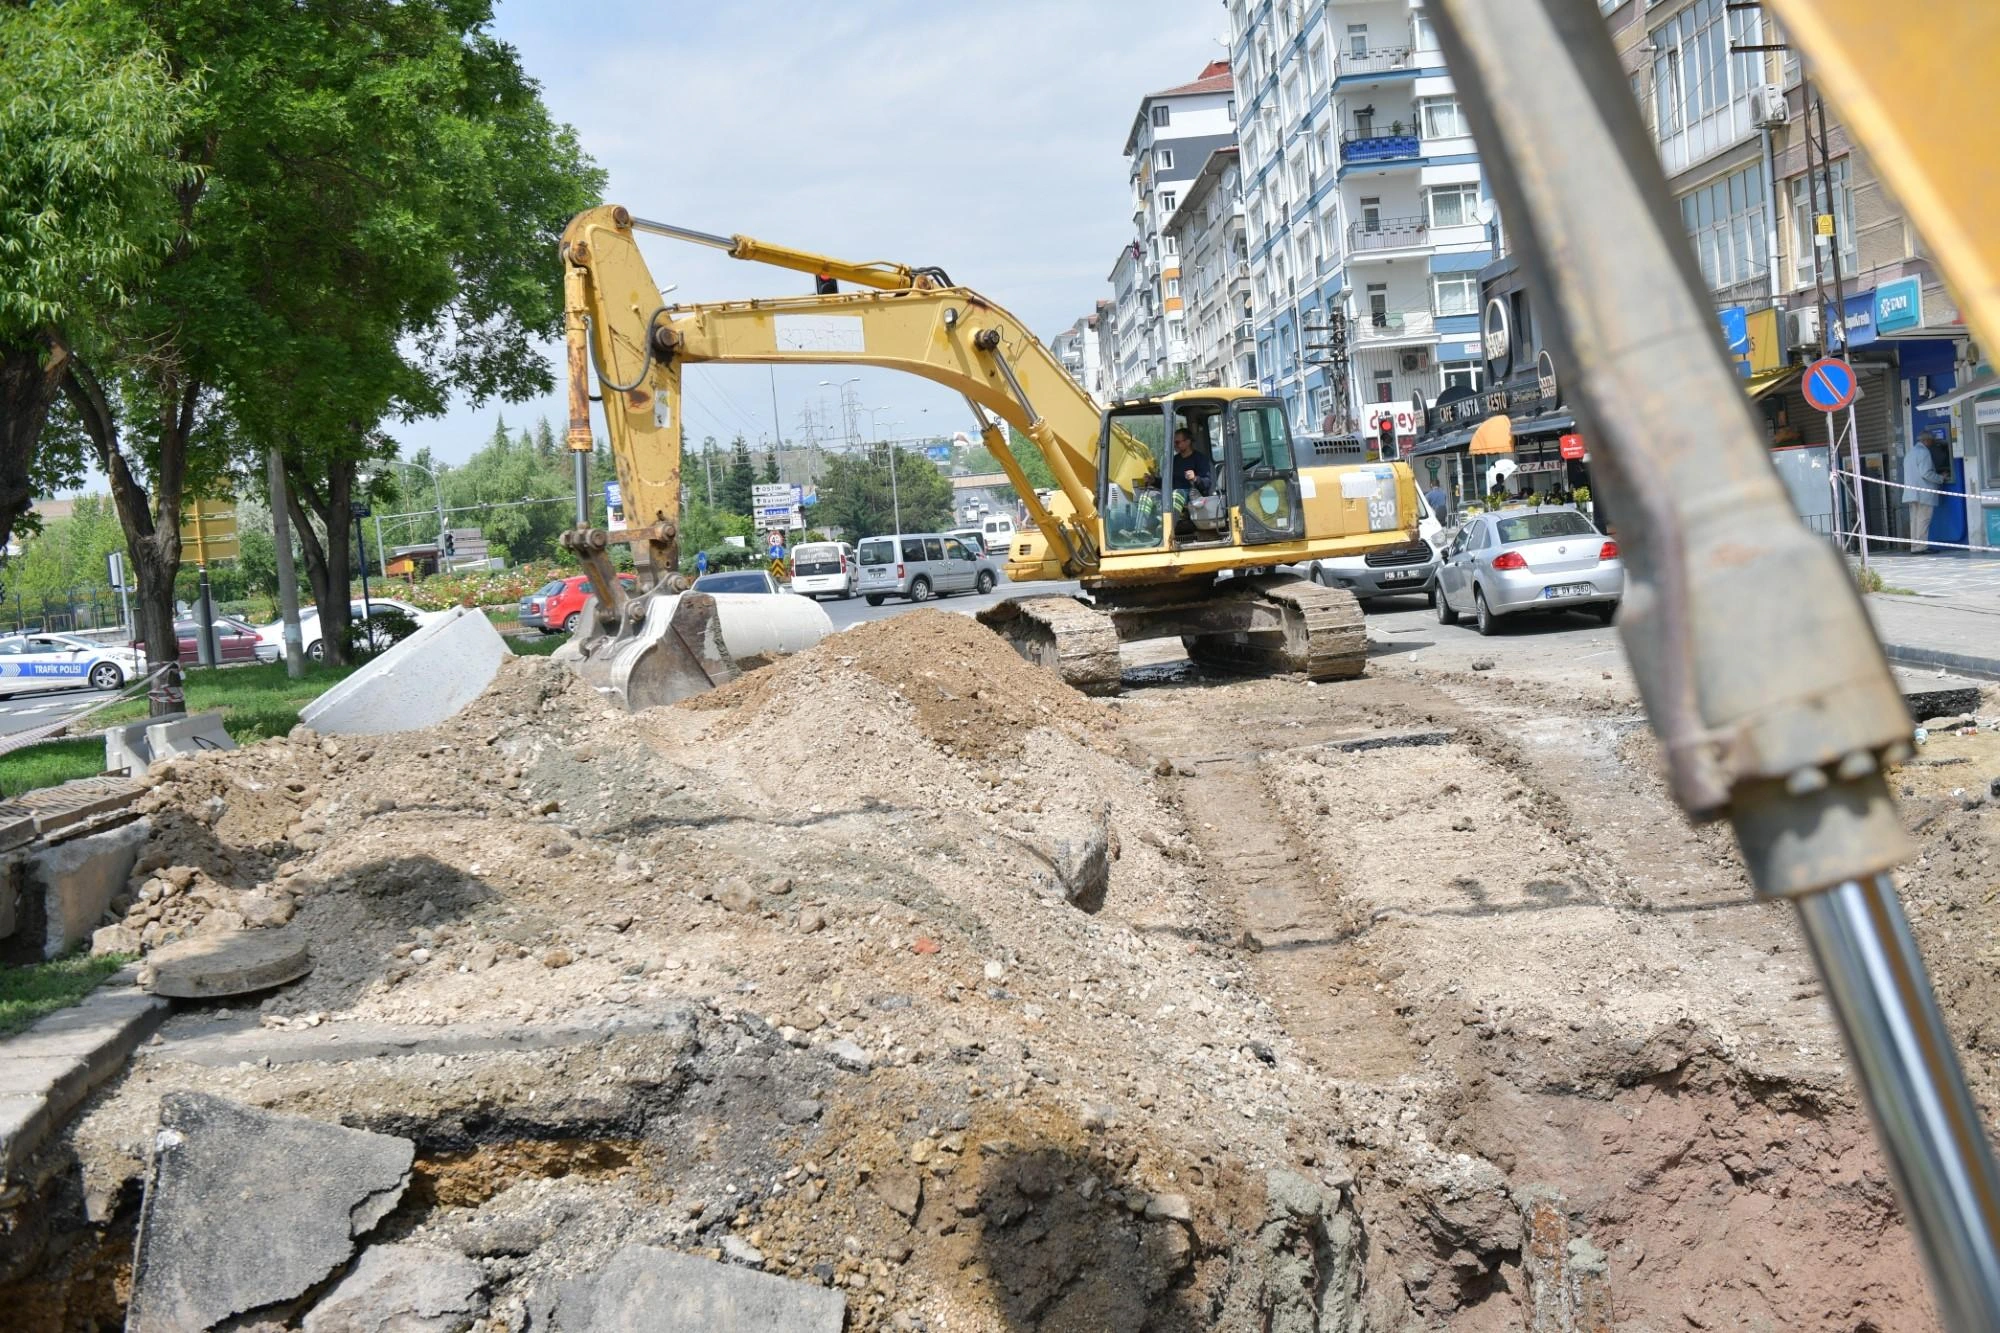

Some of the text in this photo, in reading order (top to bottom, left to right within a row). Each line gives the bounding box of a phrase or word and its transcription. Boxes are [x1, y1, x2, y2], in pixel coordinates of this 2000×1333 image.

[1440, 406, 1453, 423] CAFE
[1457, 398, 1480, 419] PASTA
[1486, 391, 1507, 412] RESTO
[1370, 500, 1395, 519] 350
[1371, 519, 1381, 530] LC
[35, 663, 81, 674] TRAFİK POLİSİ
